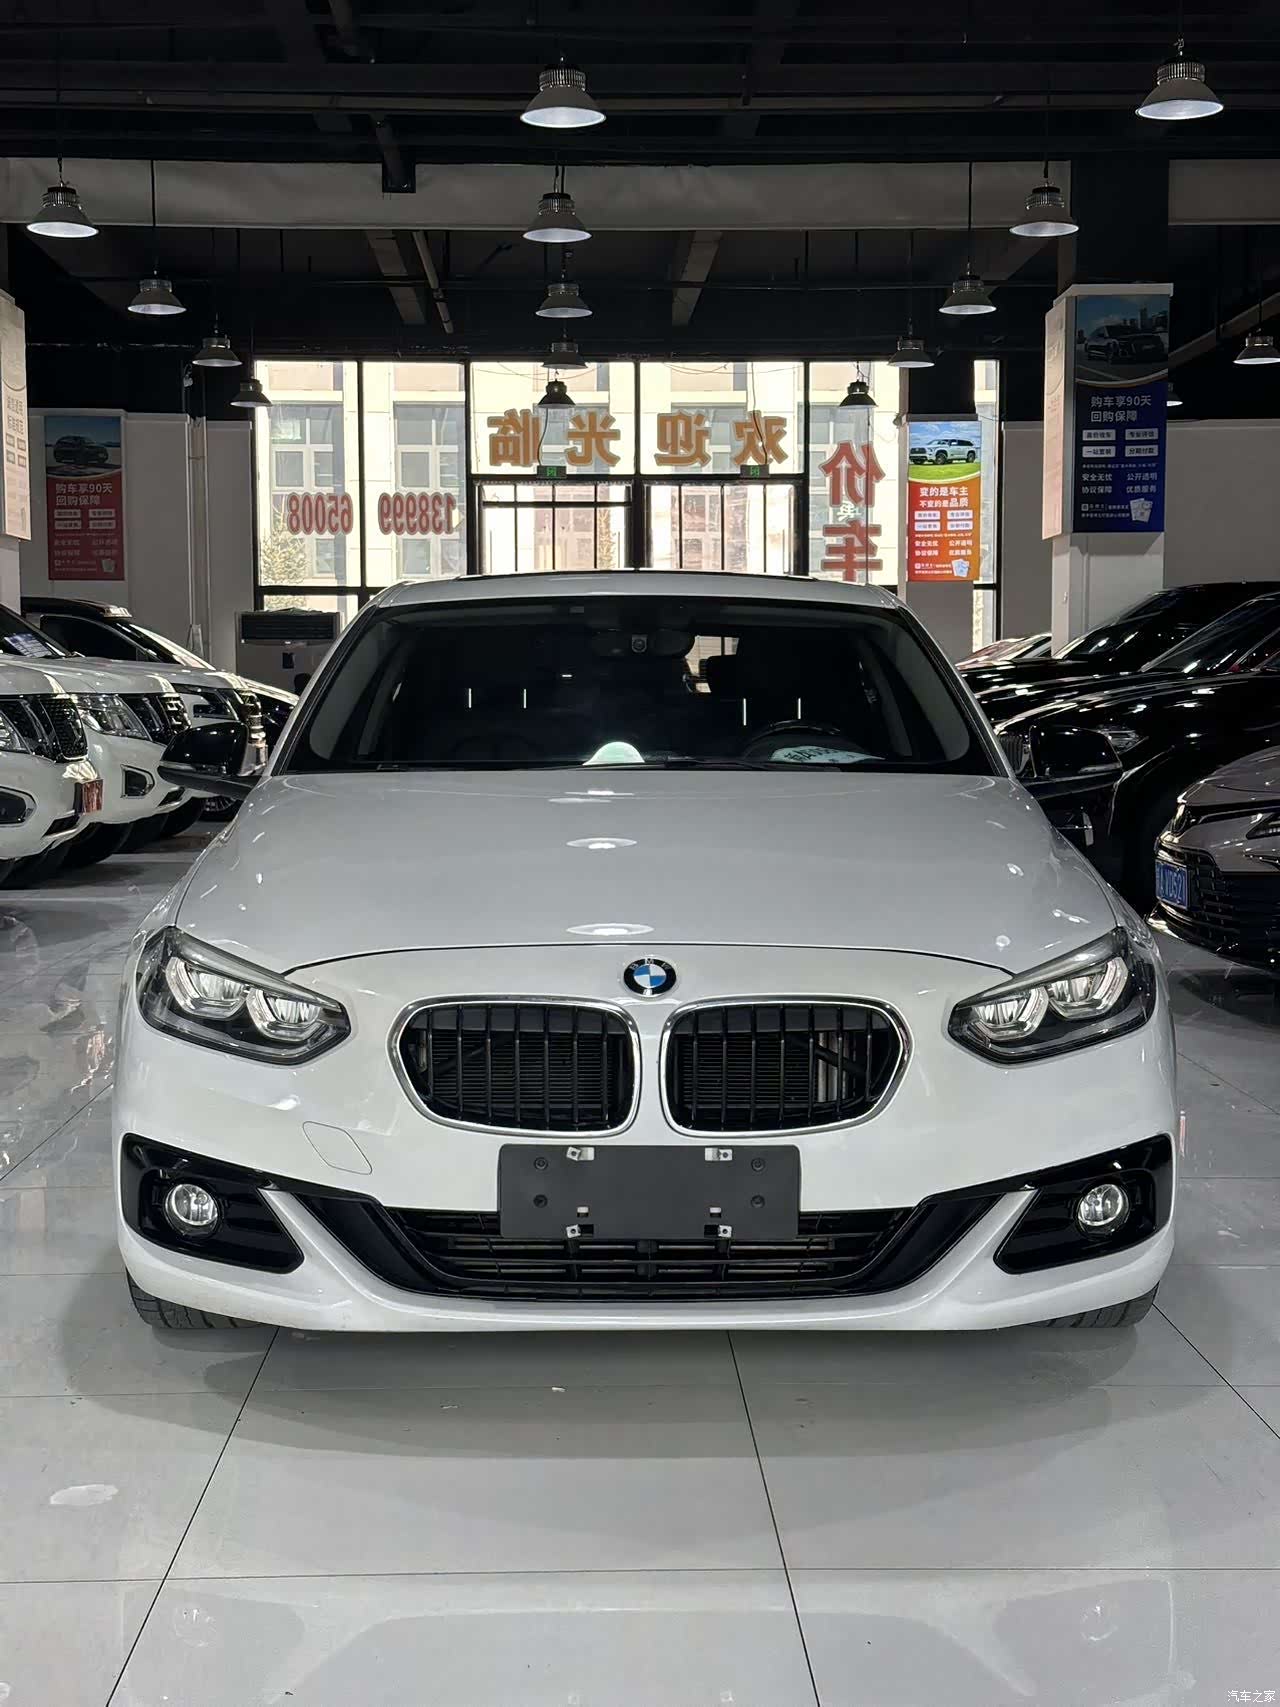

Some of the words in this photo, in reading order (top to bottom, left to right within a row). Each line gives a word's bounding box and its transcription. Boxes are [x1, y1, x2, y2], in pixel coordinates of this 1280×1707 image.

[1091, 395, 1152, 408] 购车享90天
[1091, 410, 1138, 422] 回购保障
[1082, 473, 1113, 482] 安全无忧
[1127, 472, 1158, 481] 公开透明
[919, 486, 969, 497] 变的是车主
[1082, 486, 1113, 494] 协议保障
[1126, 485, 1157, 493] 优质服务
[919, 497, 969, 508] 不变的是品质
